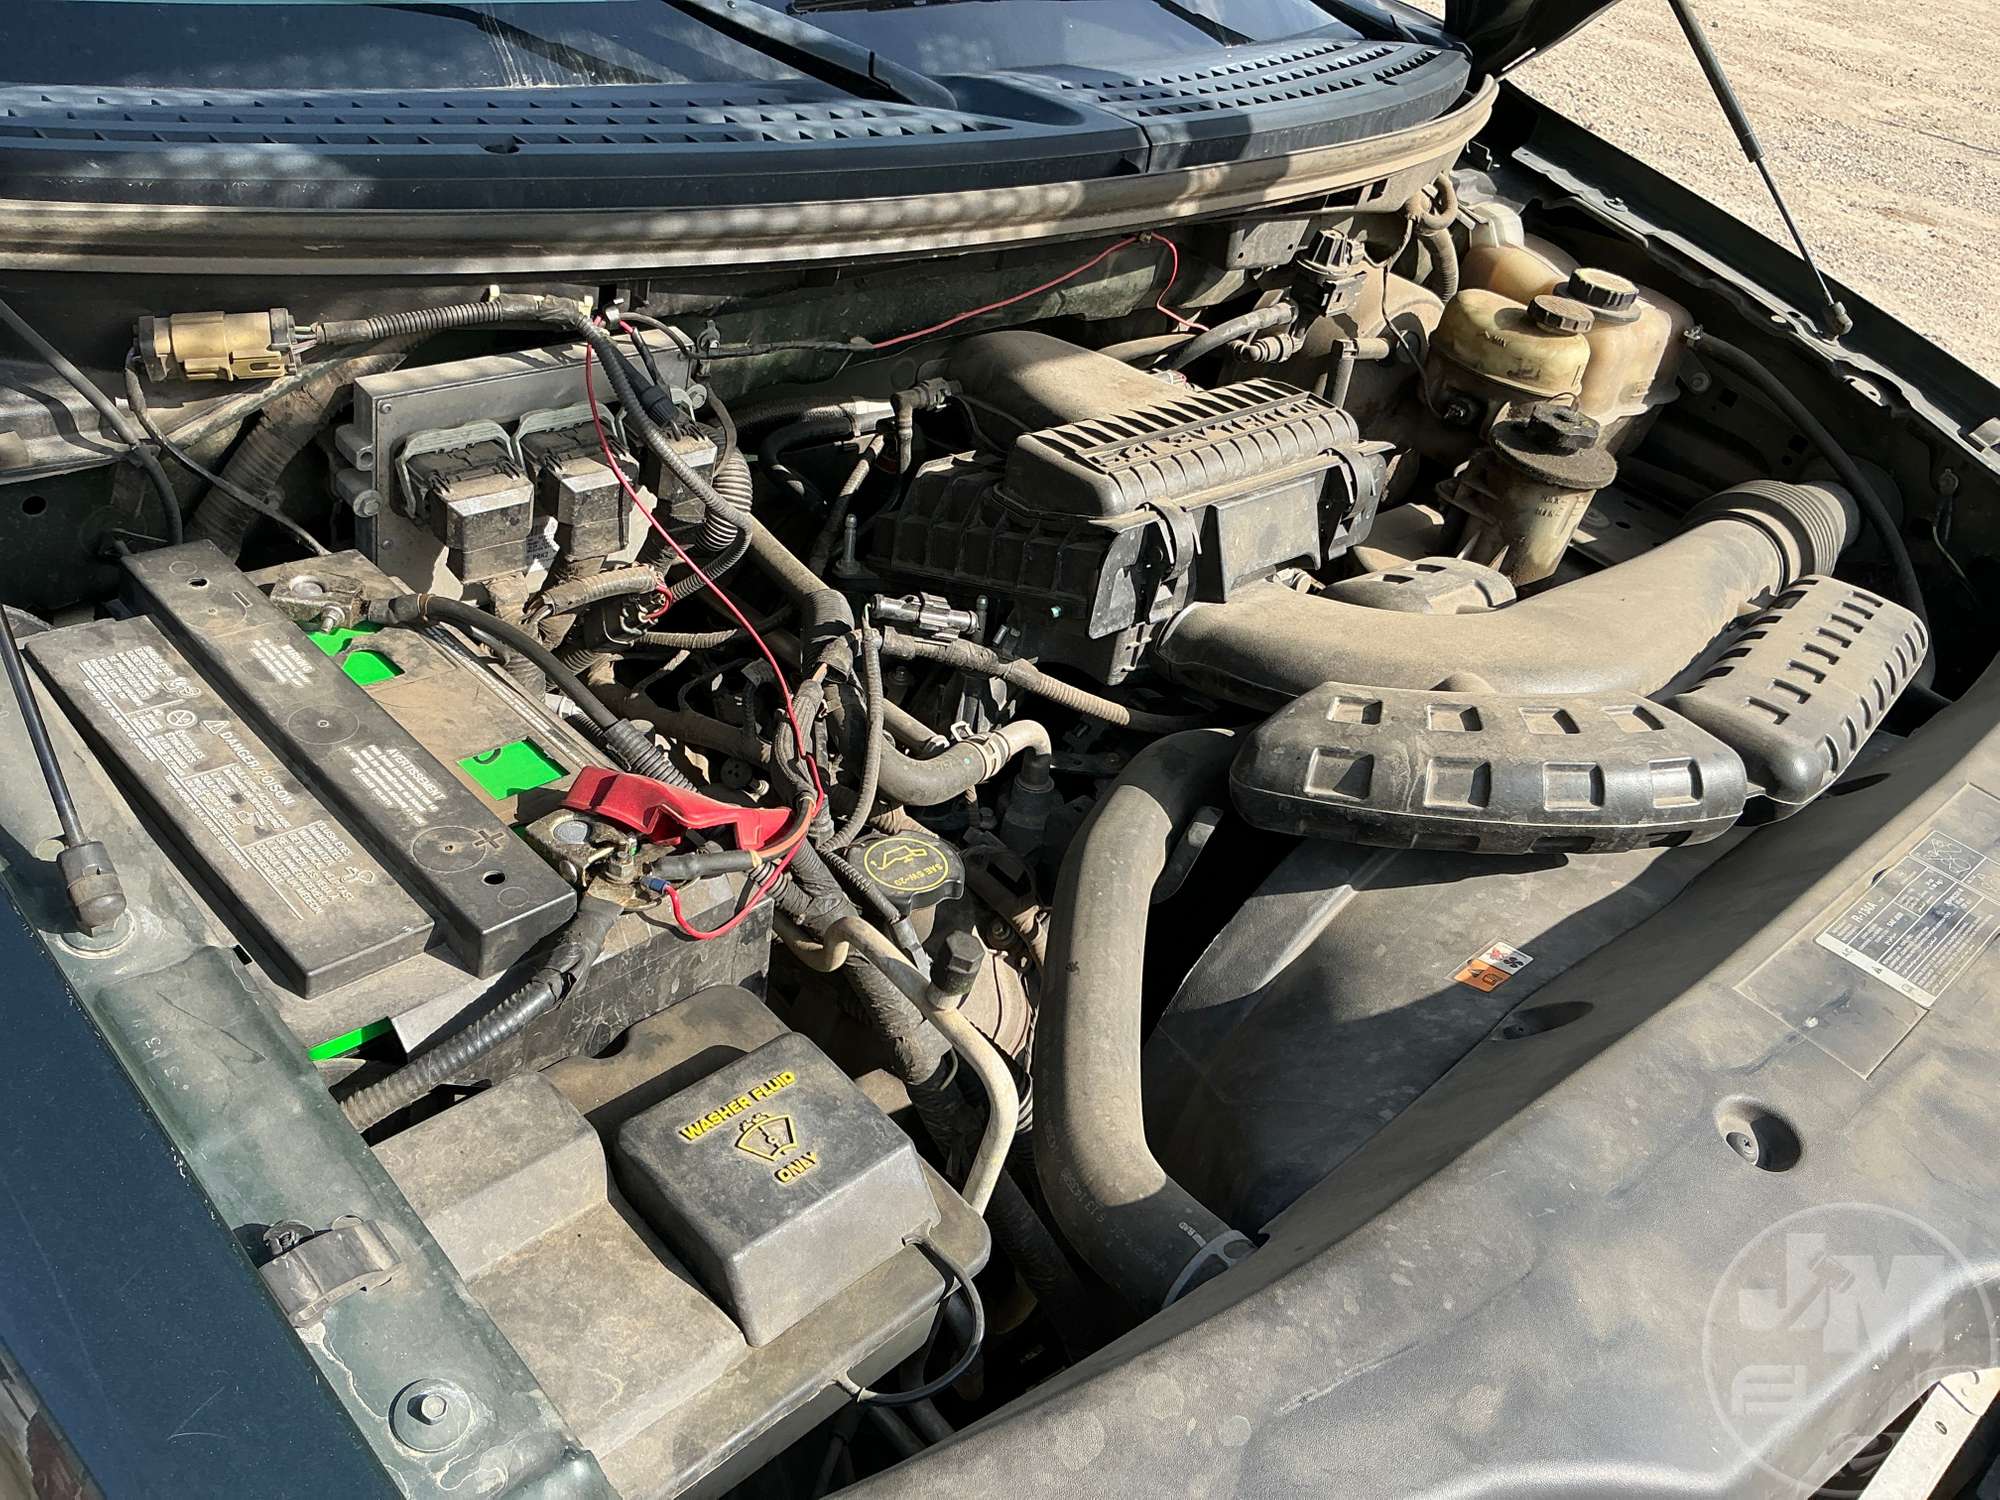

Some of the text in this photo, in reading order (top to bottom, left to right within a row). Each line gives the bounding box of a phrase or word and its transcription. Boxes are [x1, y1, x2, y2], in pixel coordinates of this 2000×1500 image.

[218, 730, 296, 806] DANGER/POISON
[1850, 900, 1878, 923] R-134A
[680, 1071, 796, 1141] WASHER FLUID
[774, 1151, 817, 1183] ONLY
